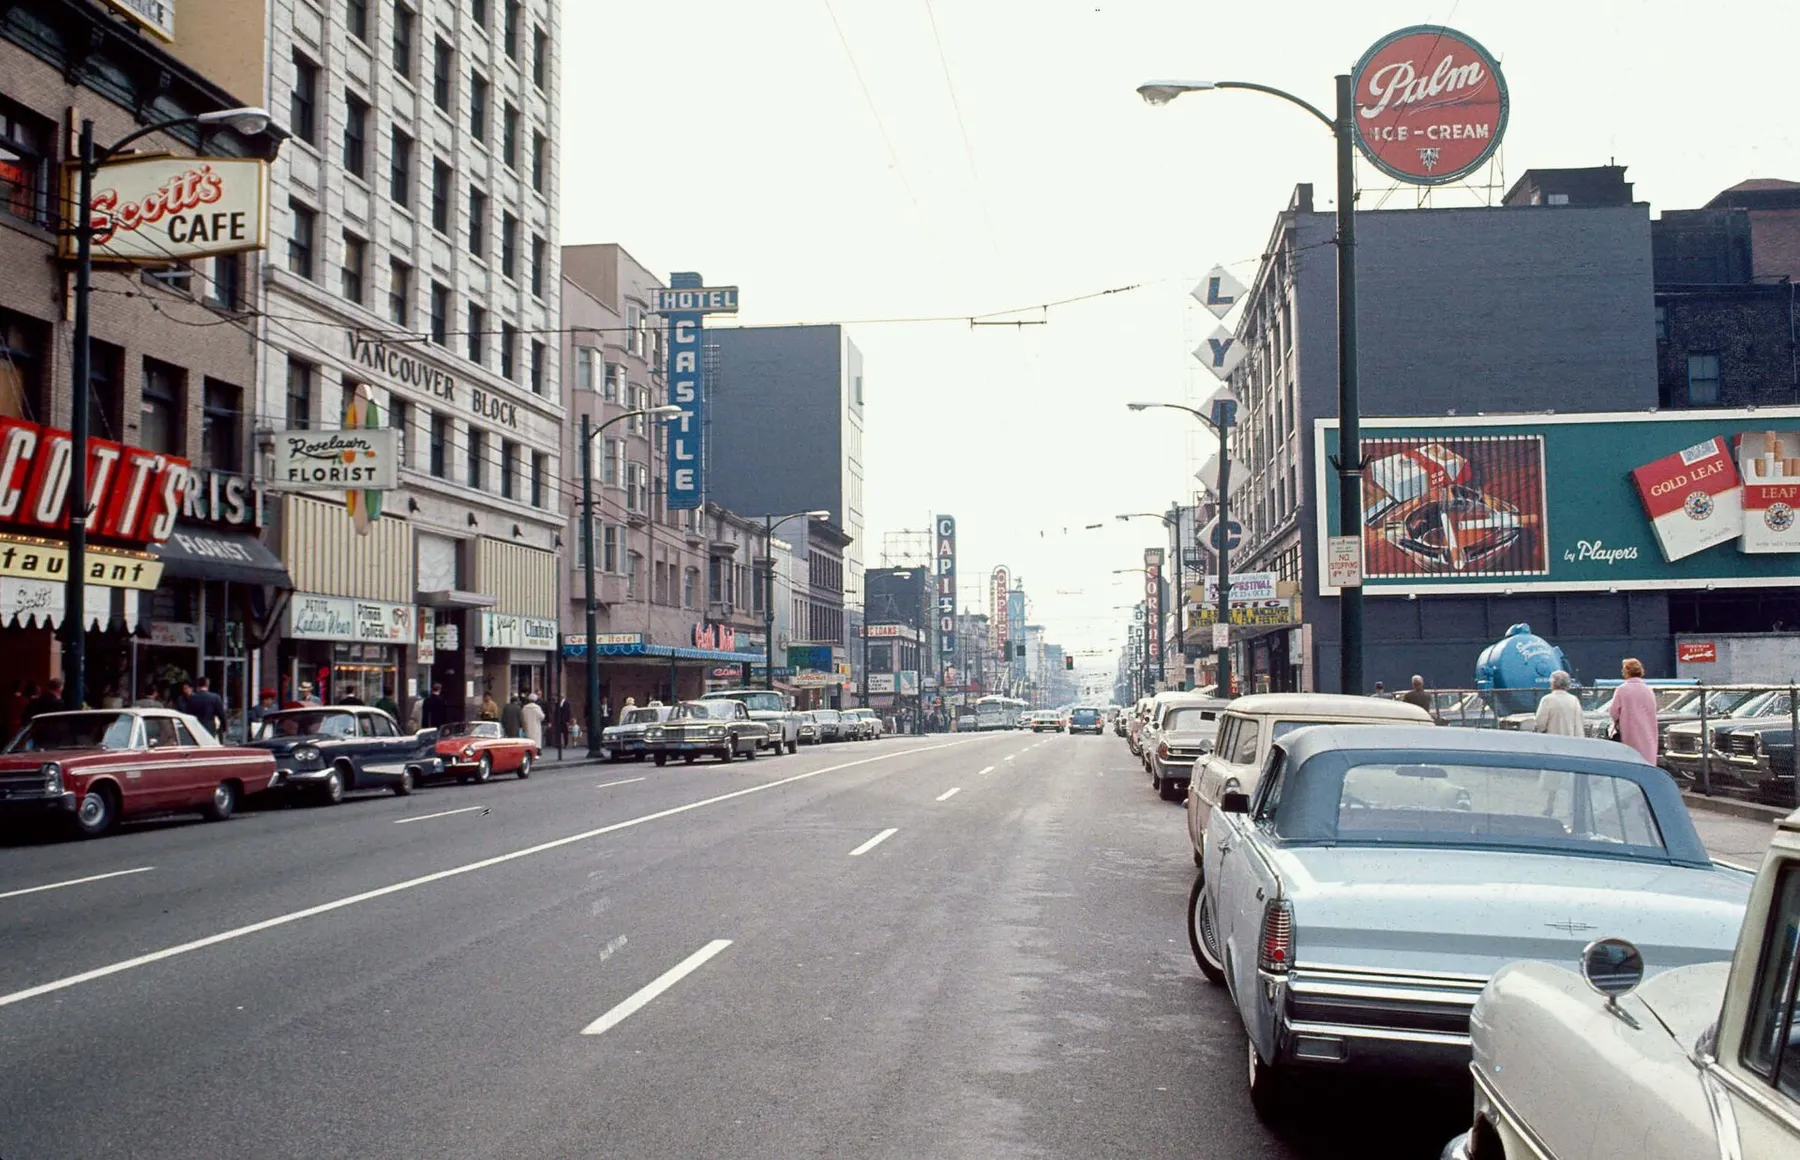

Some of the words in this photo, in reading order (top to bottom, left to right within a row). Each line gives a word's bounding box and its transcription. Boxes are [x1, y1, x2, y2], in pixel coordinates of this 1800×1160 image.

[1361, 55, 1484, 119] Palm
[90, 165, 222, 245] Scott's
[168, 212, 245, 243] CAFE
[664, 291, 736, 308] HOTEL
[347, 331, 456, 401] VANCOUVER
[472, 389, 518, 429] BLOCK
[675, 320, 696, 490] CASTLE
[288, 435, 371, 460] Roselawn
[289, 467, 376, 481] FLORIST
[1651, 475, 1688, 496] GOLD
[1690, 460, 1725, 481] LEAF
[1761, 487, 1797, 499] LEAF
[173, 532, 253, 561] FLORIST
[1339, 553, 1350, 561] NO
[1564, 549, 1575, 562] by
[1577, 540, 1639, 564] Player's
[3, 547, 144, 582] tauant
[939, 520, 953, 651] CAPITOL
[1233, 580, 1272, 591] FESTIVAL
[1196, 600, 1280, 611] LRIC
